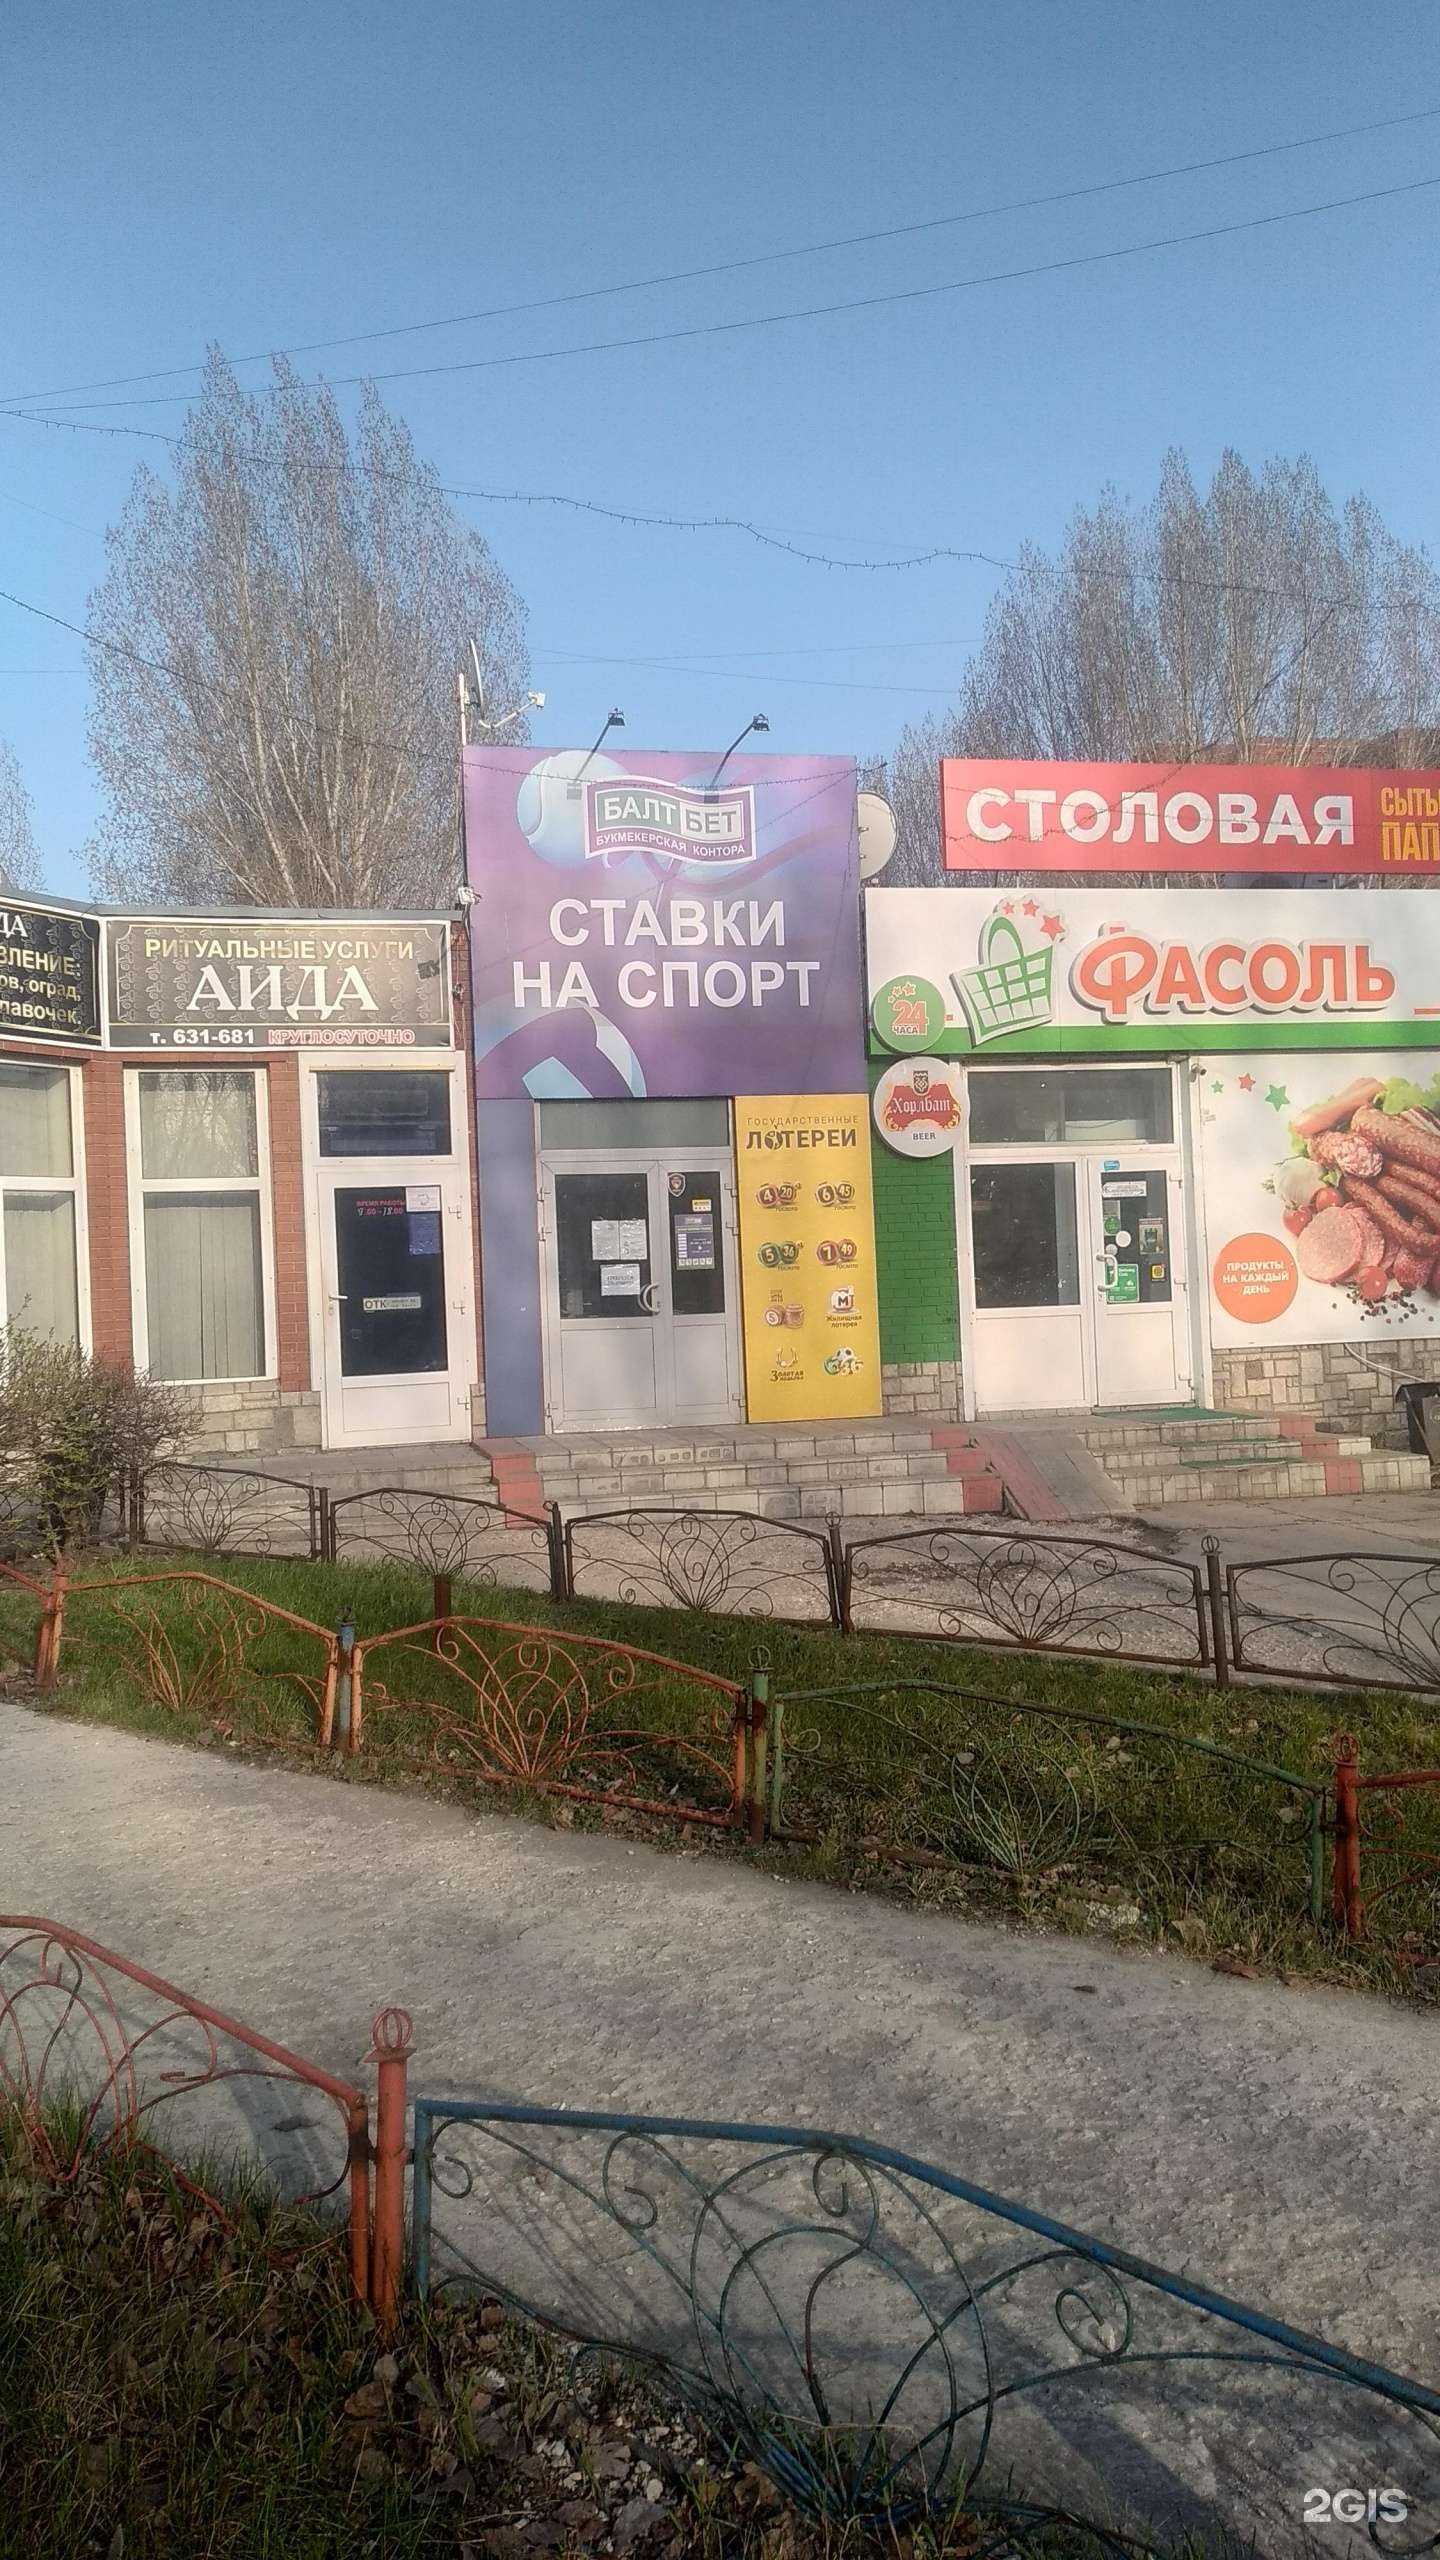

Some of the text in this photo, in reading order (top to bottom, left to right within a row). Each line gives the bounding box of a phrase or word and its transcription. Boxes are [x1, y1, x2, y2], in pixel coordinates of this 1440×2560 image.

[965, 787, 1355, 846] СТОЛОВАЯ
[596, 831, 745, 857] БУКМЕКЕРСКАЯ КОНТОРА
[549, 898, 785, 947] СТАВКИ
[145, 938, 414, 961] РИТУАЛЬНЫЕ УСЛУГИ
[1080, 926, 1396, 1016] ФАСОЛЬ
[28, 978, 81, 1002] оград,
[186, 963, 380, 1021] АИДА
[512, 960, 821, 1009] НА СПОРТ
[893, 999, 929, 1035] 24
[150, 1028, 415, 1045] т. 631-681 КРУГЛОСУТОЧНО
[893, 1025, 918, 1035] ЧАСА
[746, 1114, 859, 1127] ГОСУДАРСТВЕННЫЕ
[746, 1126, 857, 1150] ЛОТЕРЕИ
[912, 1132, 937, 1141] BEER
[1222, 1271, 1289, 1283] НА КАЖДЫЙ
[1226, 1260, 1286, 1271] ПРОДУКТЫ
[1242, 1284, 1271, 1296] ДЕНЬ
